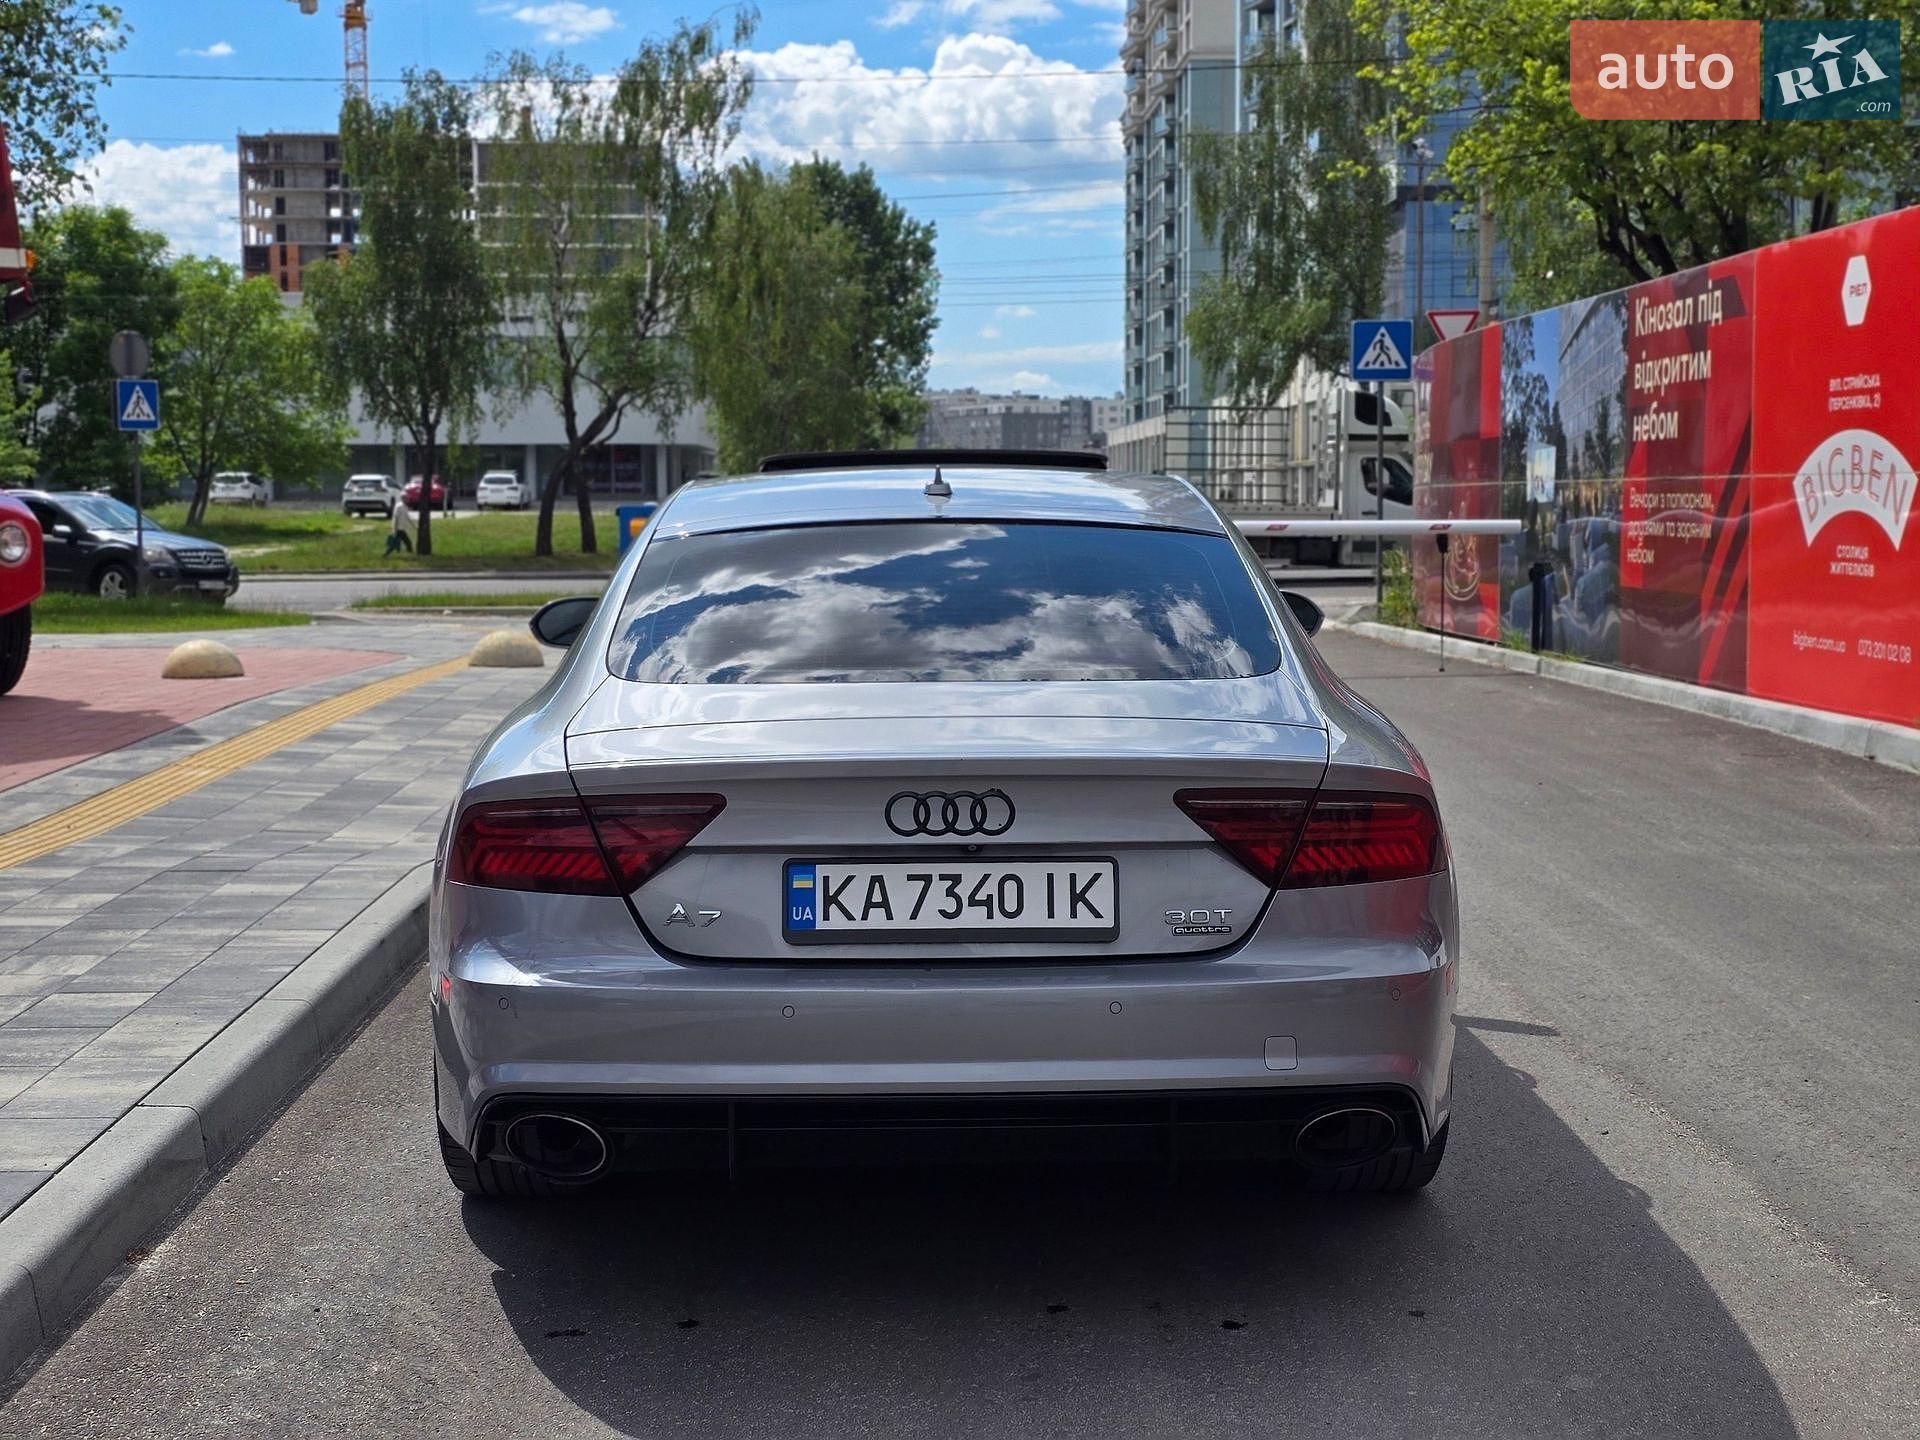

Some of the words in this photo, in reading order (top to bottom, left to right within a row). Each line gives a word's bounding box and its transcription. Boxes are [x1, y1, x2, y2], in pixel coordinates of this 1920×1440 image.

[1635, 297, 1693, 337] Кінозал
[1698, 279, 1722, 327] під
[1634, 351, 1712, 396] відкритим
[1633, 401, 1678, 441] небом
[792, 906, 813, 920] UA
[822, 874, 894, 921] KA
[906, 873, 1024, 920] 7340
[1046, 872, 1104, 919] IK
[1175, 926, 1231, 935] quattro
